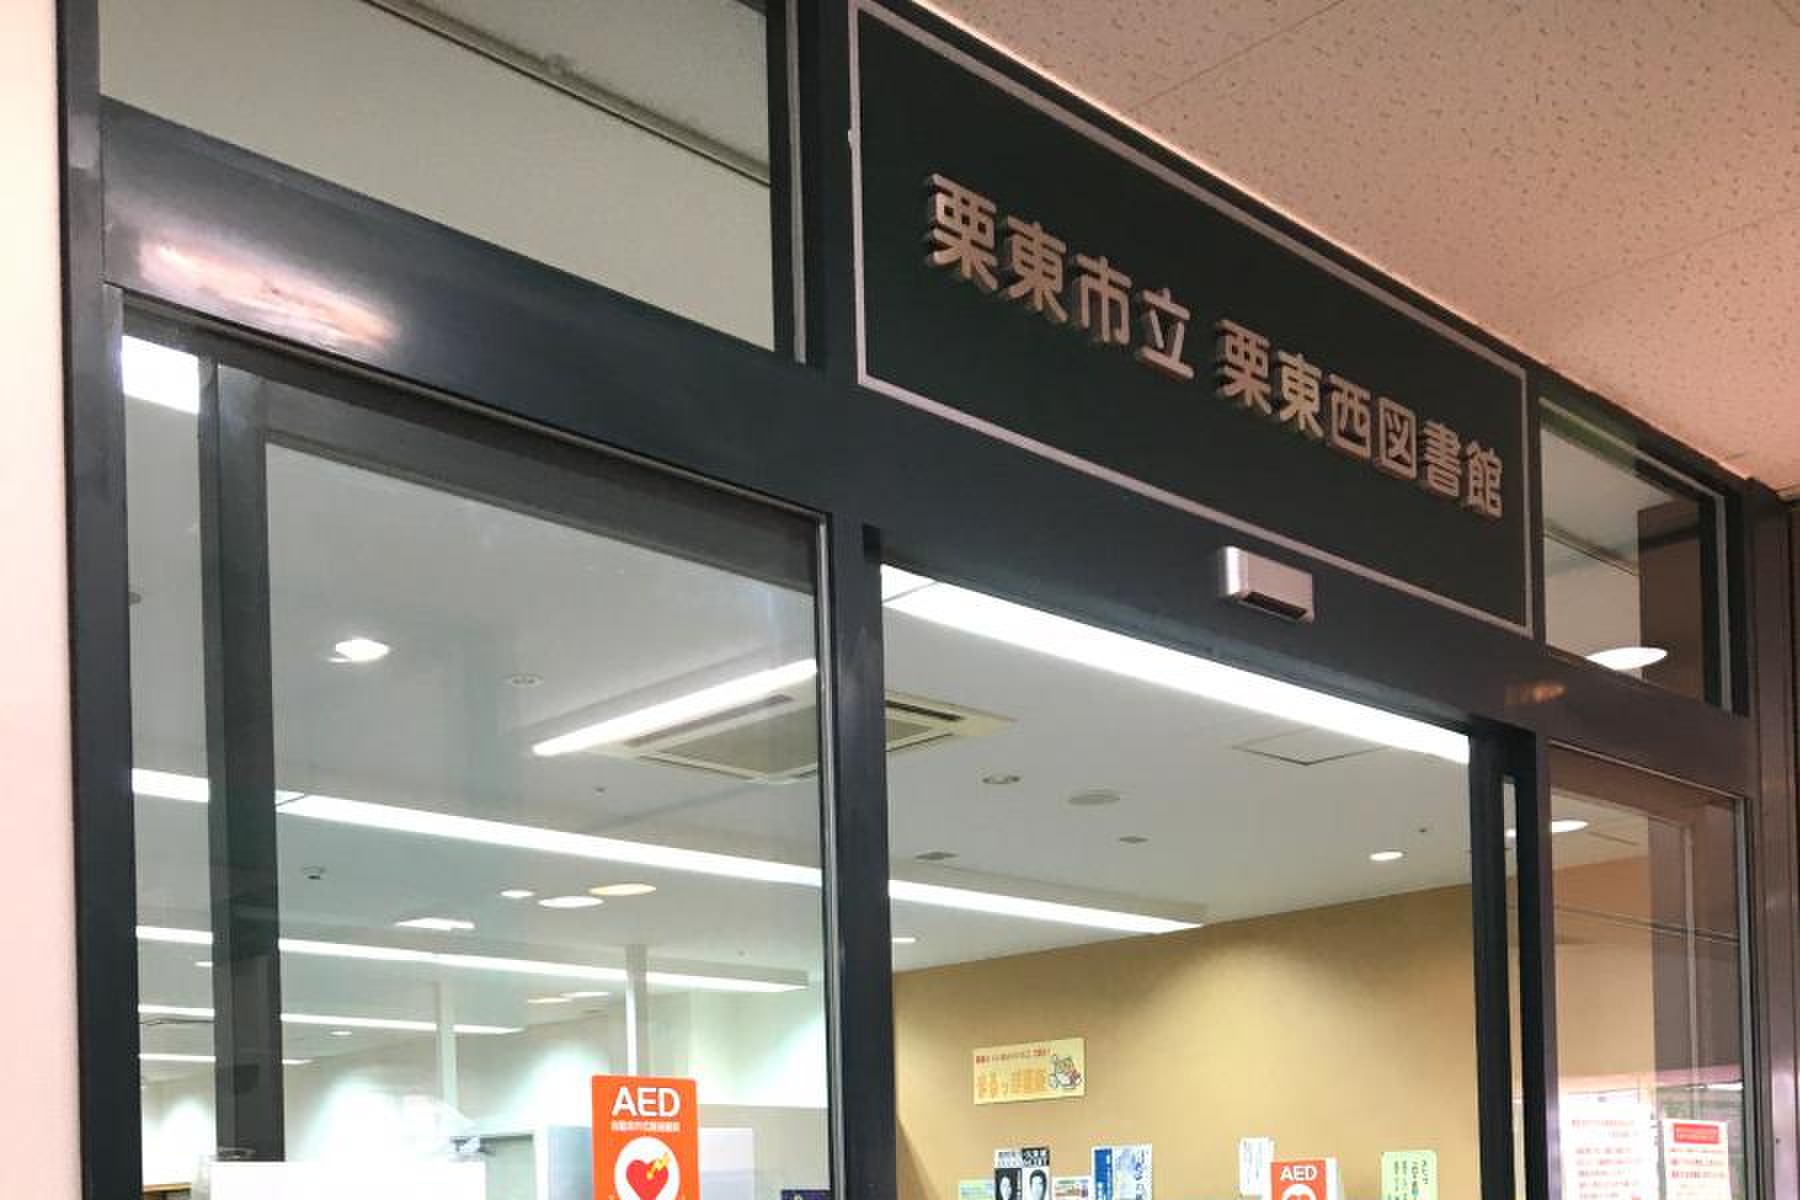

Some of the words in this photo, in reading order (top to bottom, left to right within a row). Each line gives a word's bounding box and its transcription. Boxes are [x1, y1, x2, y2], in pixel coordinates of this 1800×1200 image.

[925, 172, 1195, 380] 栗東市立
[1215, 318, 1504, 519] 栗東西図書館
[611, 1087, 681, 1117] AED
[1279, 1164, 1318, 1182] AED
